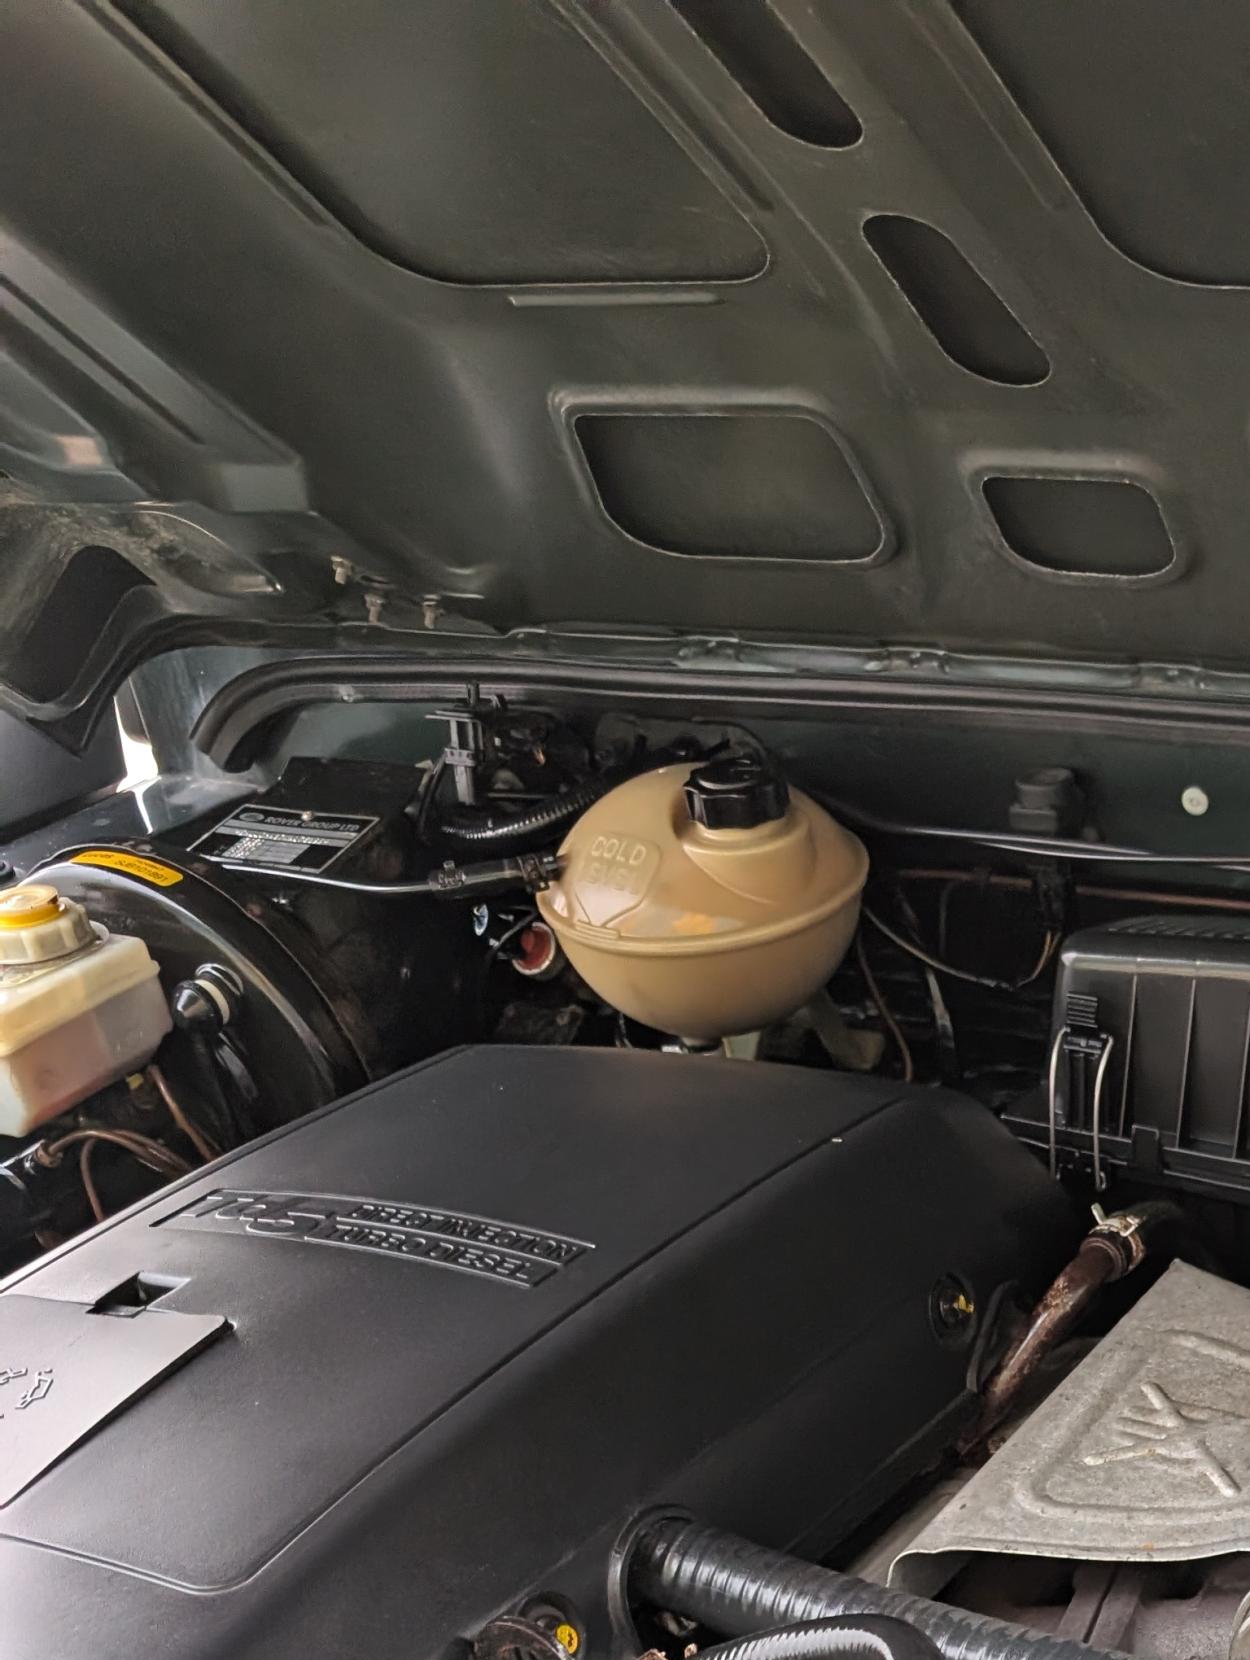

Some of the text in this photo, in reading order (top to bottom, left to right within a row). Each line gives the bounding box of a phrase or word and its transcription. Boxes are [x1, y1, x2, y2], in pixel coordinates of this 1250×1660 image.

[264, 815, 301, 828] ROVER
[338, 823, 360, 832] LTD
[591, 836, 647, 866] COLD
[333, 1223, 536, 1281] TURBO DIESEL
[349, 1203, 579, 1259] DIRECT INJECTION
